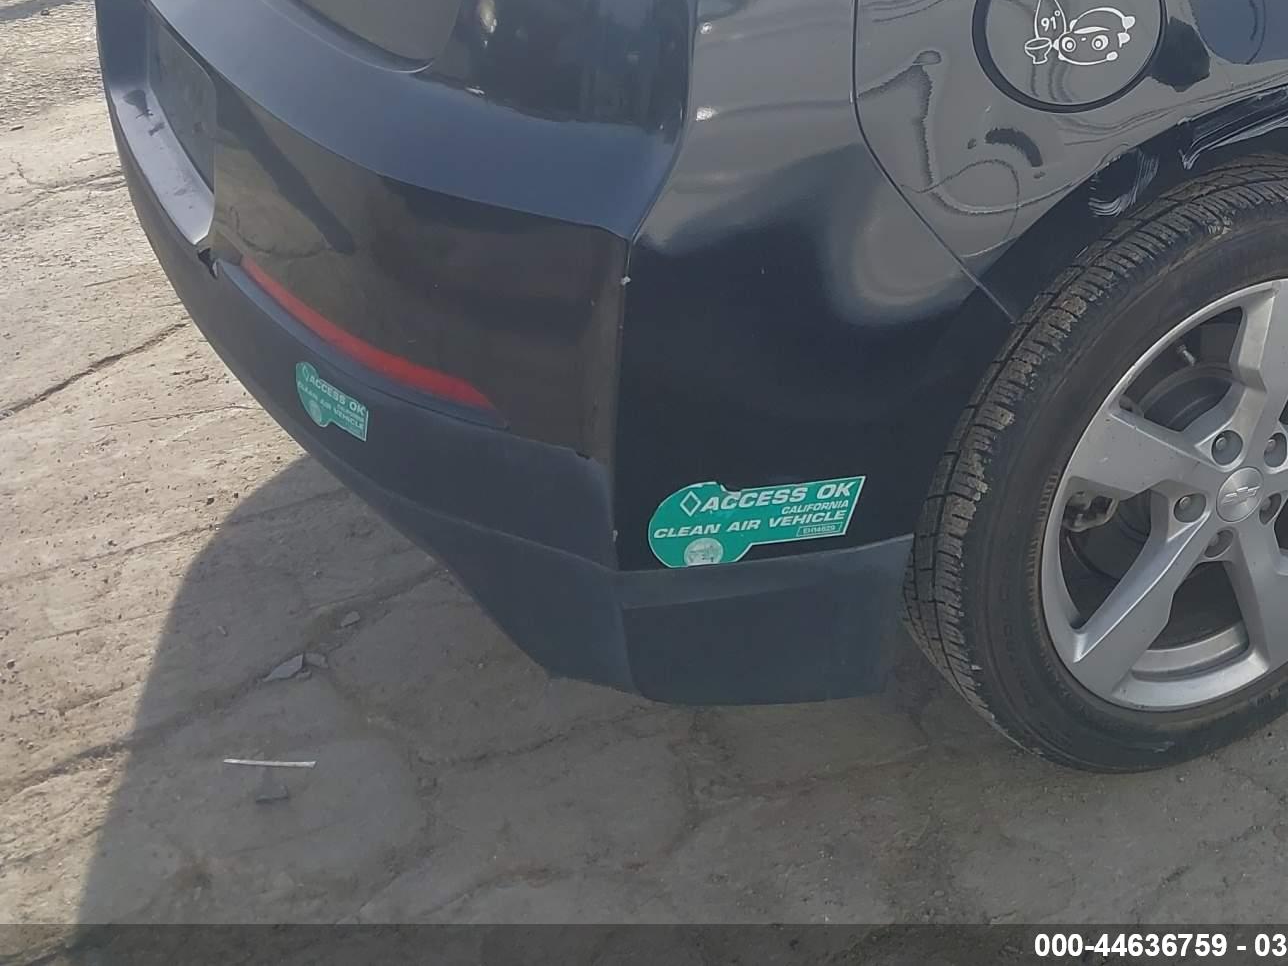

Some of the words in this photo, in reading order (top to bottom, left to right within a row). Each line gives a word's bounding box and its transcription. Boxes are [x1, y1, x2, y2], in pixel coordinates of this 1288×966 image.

[309, 375, 346, 405] ACCESS
[349, 401, 367, 416] OK
[700, 487, 808, 512] ACCESS
[816, 481, 857, 500] OK
[781, 499, 849, 515] CALIFORNIA
[653, 523, 721, 539] CLEAN
[726, 519, 761, 532] AIR
[769, 509, 848, 528] VEHICLE
